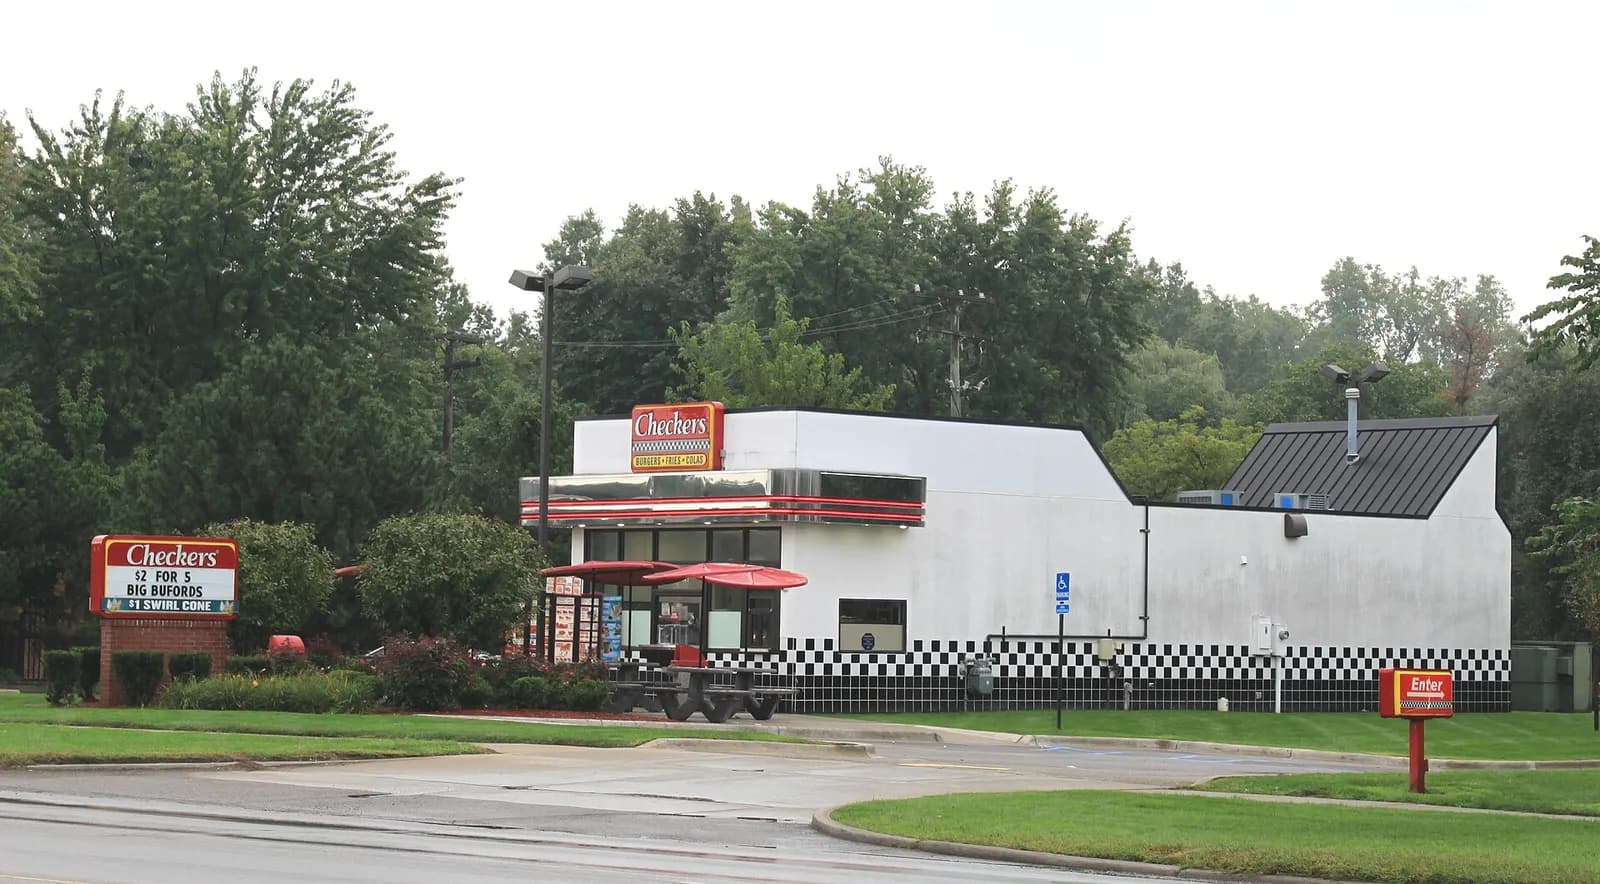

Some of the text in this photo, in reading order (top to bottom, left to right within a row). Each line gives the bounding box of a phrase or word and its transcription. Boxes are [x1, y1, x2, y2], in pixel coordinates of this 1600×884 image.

[635, 410, 706, 437] Checkers
[635, 455, 704, 466] BURGERS FRIES COLAS
[127, 544, 217, 567] Checkers
[135, 570, 191, 583] $2 FOR 5
[127, 584, 203, 597] BIG BUFORDS
[129, 599, 211, 611] $1 SWIRL CONE
[1411, 677, 1443, 691] Enter
